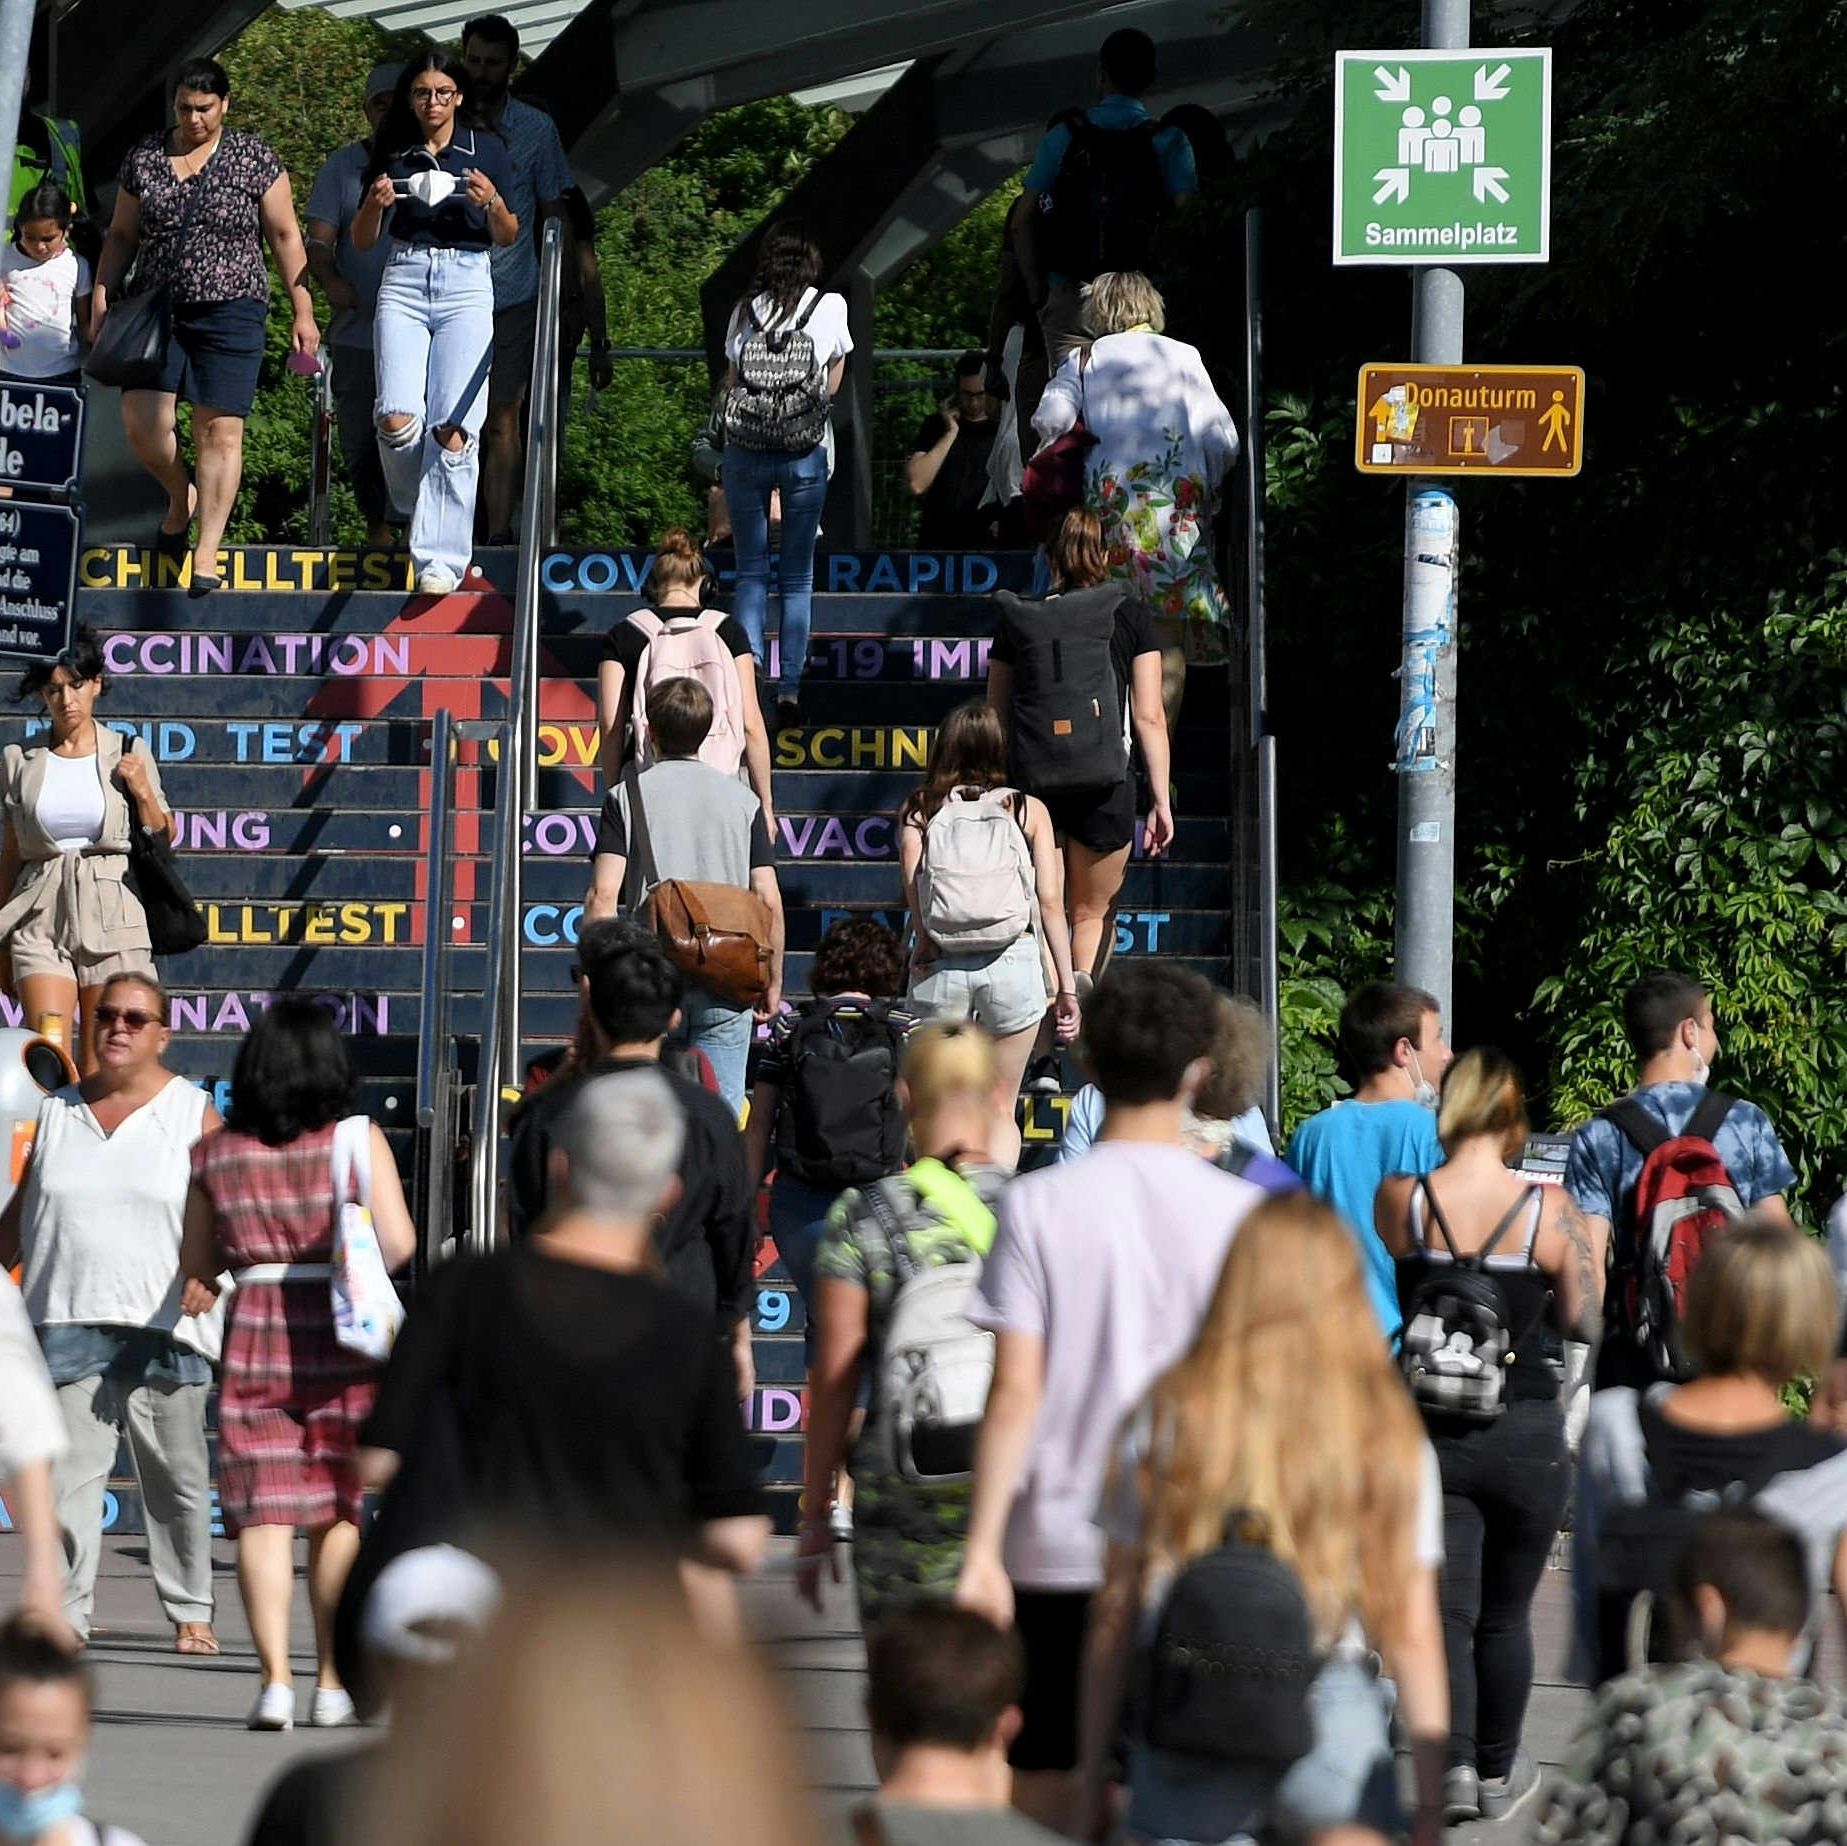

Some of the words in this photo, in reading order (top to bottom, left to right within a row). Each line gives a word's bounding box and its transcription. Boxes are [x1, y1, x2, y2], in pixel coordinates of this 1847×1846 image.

[1365, 222, 1518, 249] Sammelplatz
[1405, 382, 1536, 409] Donauturm
[19, 548, 40, 563] am
[12, 568, 32, 589] die
[80, 548, 416, 591] CHNELLTEST
[829, 554, 998, 593] RAPID
[19, 631, 42, 646] vor.
[102, 634, 409, 674] CCINATION
[227, 724, 363, 763] TEST
